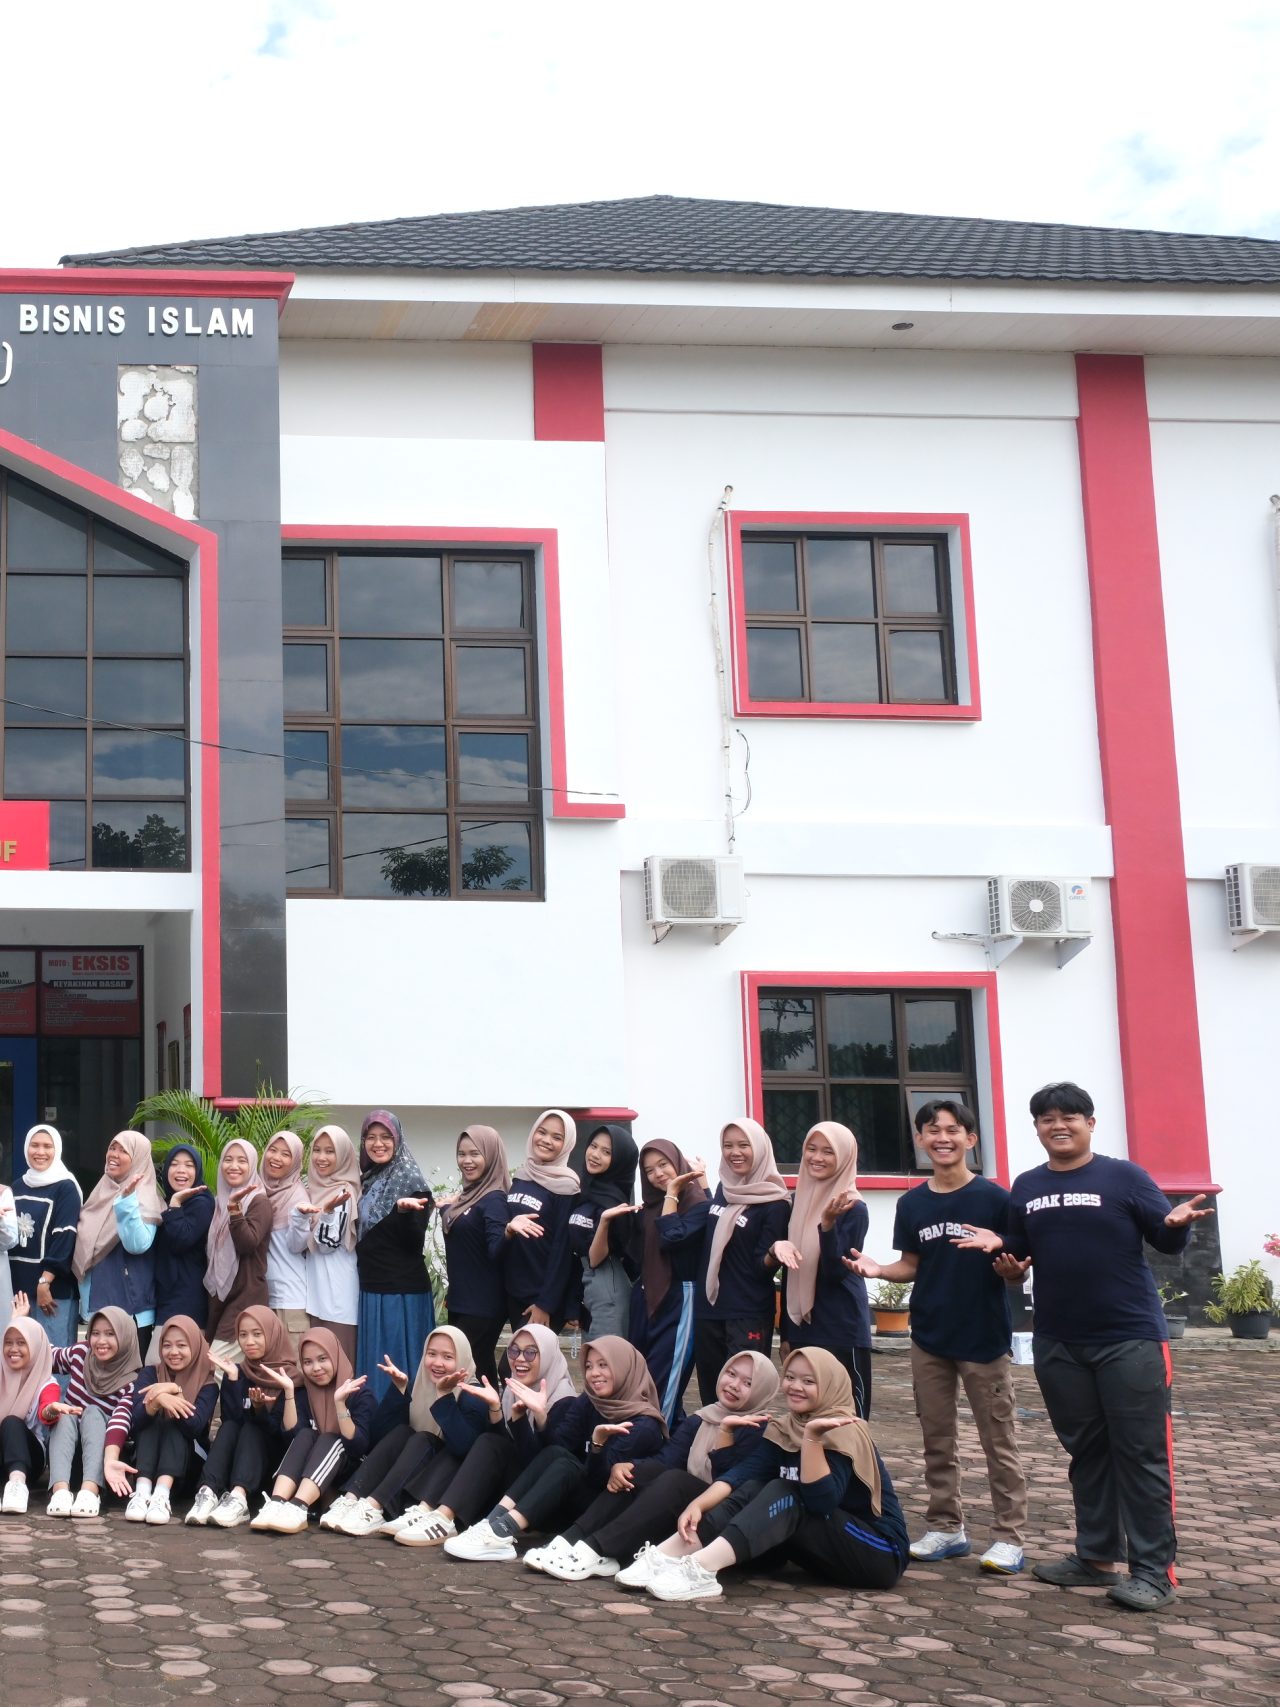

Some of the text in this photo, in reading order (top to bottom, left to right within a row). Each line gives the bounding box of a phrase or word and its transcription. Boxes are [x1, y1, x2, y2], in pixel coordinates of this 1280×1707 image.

[19, 304, 126, 334] BISNIS
[148, 306, 254, 336] ISLAM
[72, 955, 130, 971] EKSIS
[53, 980, 126, 988] KEYAKINAN DASAR
[1026, 1193, 1101, 1214] PBAK 2025
